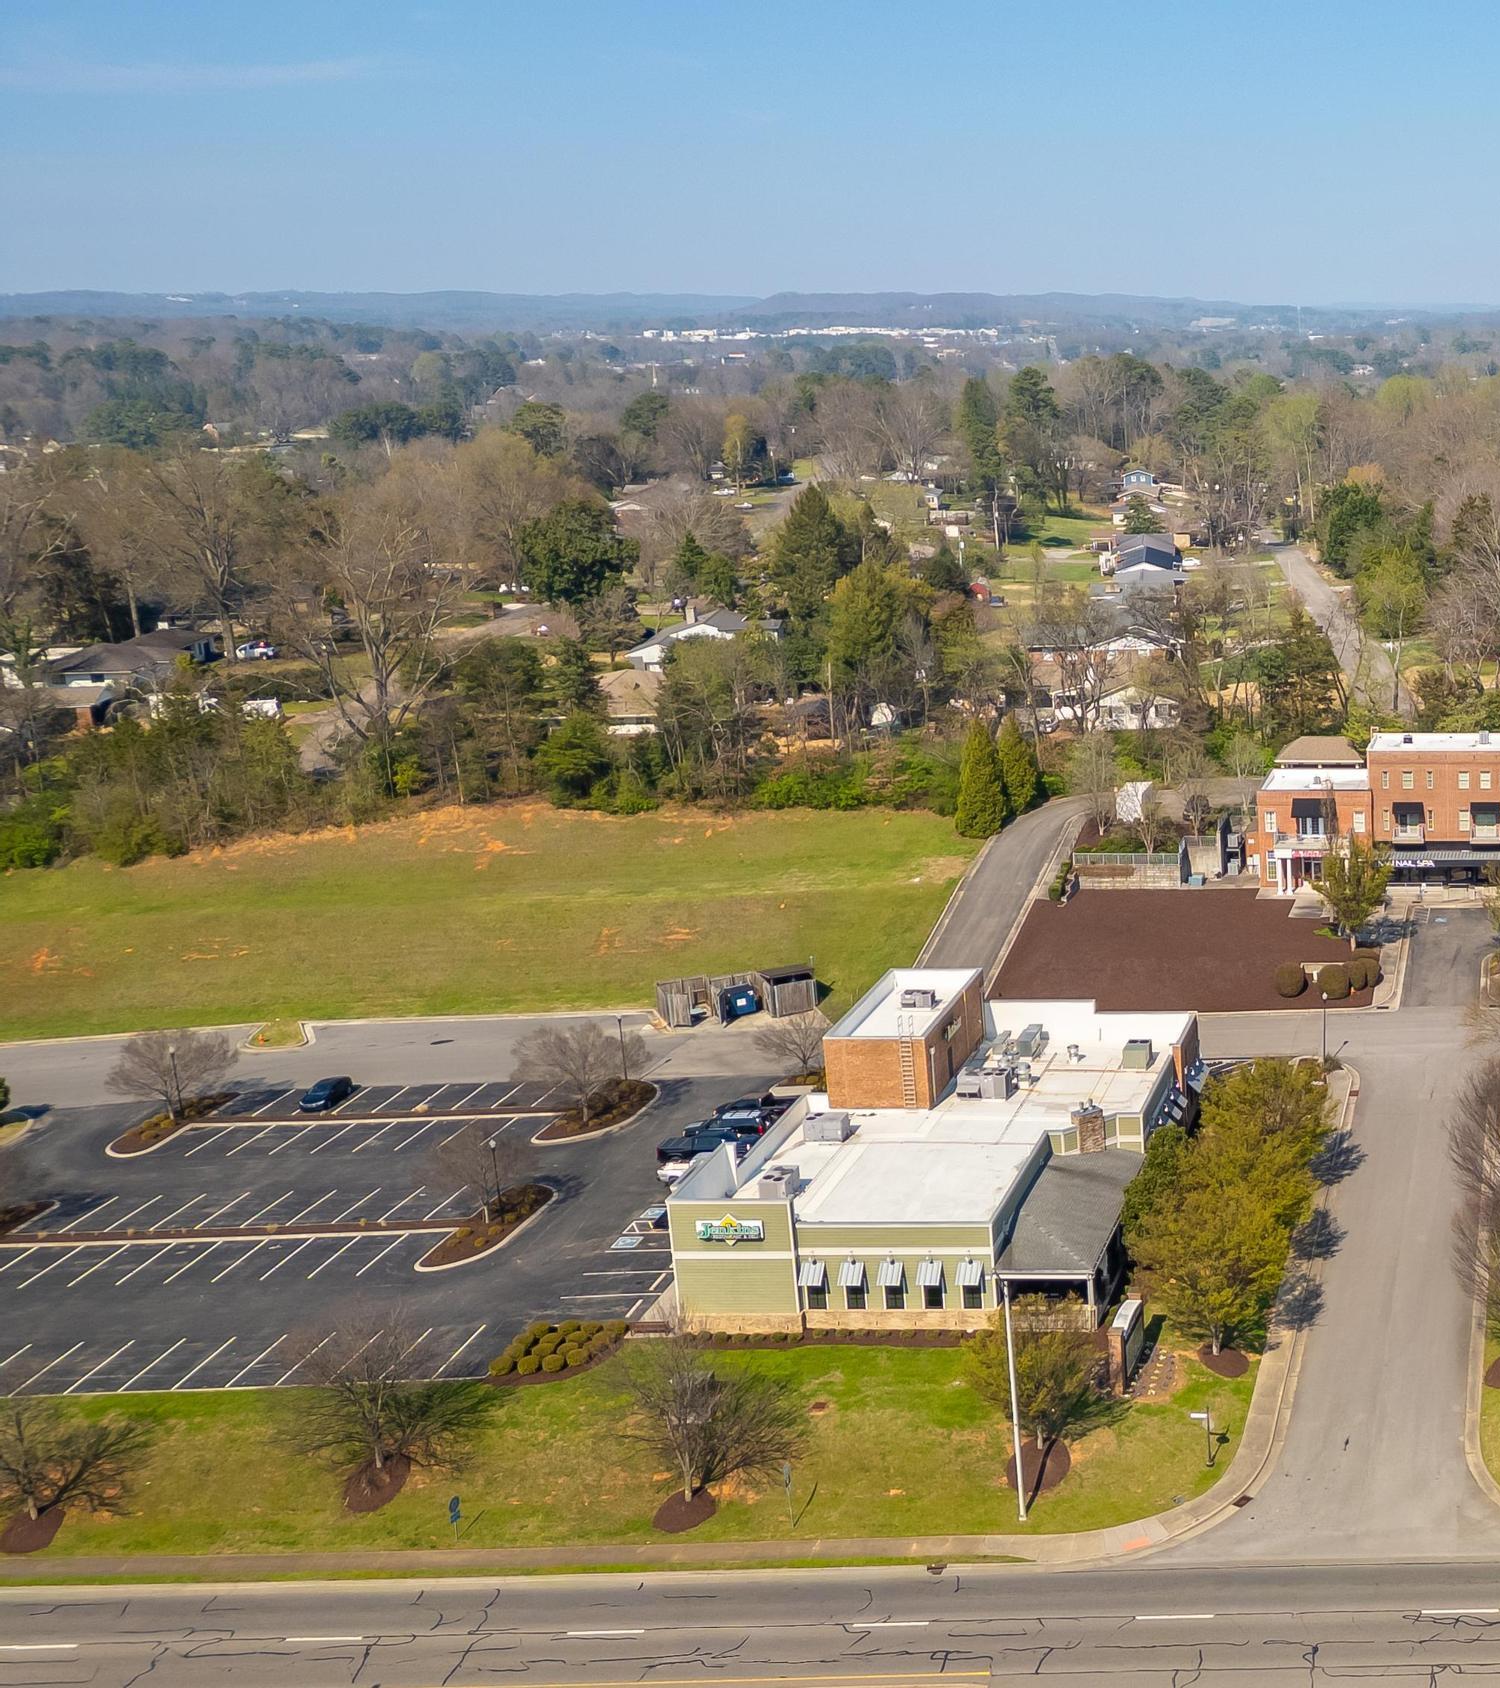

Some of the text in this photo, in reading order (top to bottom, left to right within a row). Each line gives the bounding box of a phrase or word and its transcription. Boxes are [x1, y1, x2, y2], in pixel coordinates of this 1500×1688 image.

[1395, 859, 1416, 868] NAIL
[1416, 859, 1436, 868] SPA
[697, 1222, 762, 1239] Jenkins
